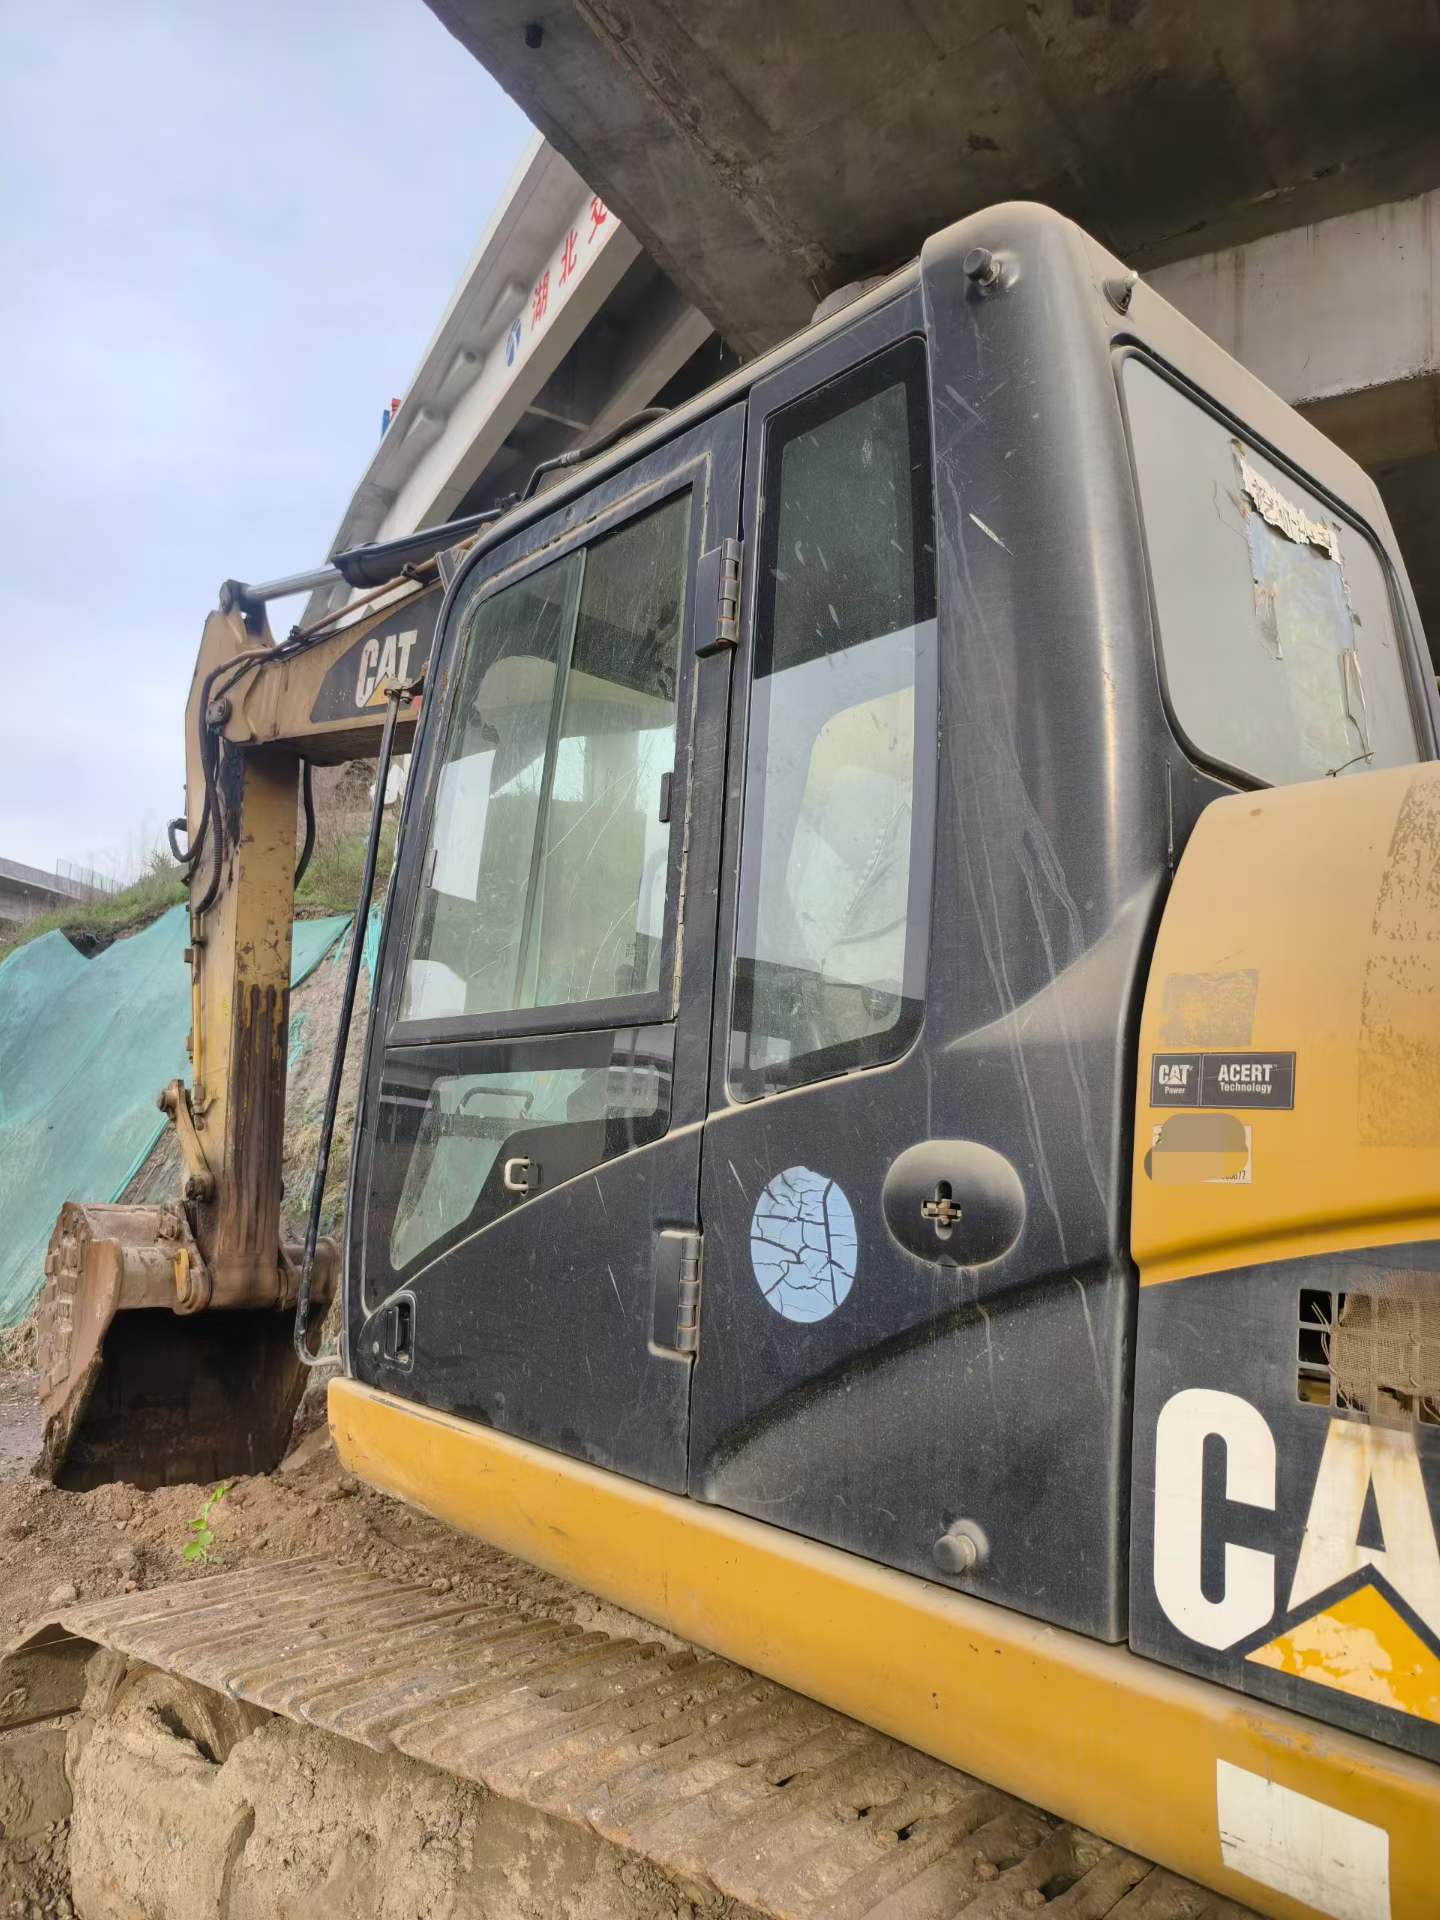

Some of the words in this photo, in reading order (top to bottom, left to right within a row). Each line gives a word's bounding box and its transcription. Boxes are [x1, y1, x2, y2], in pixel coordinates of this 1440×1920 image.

[355, 630, 418, 708] CAT
[1158, 1064, 1190, 1085] CAT
[1218, 1064, 1273, 1082] ACERT
[1164, 1086, 1186, 1095] Power
[1219, 1082, 1273, 1094] Technology
